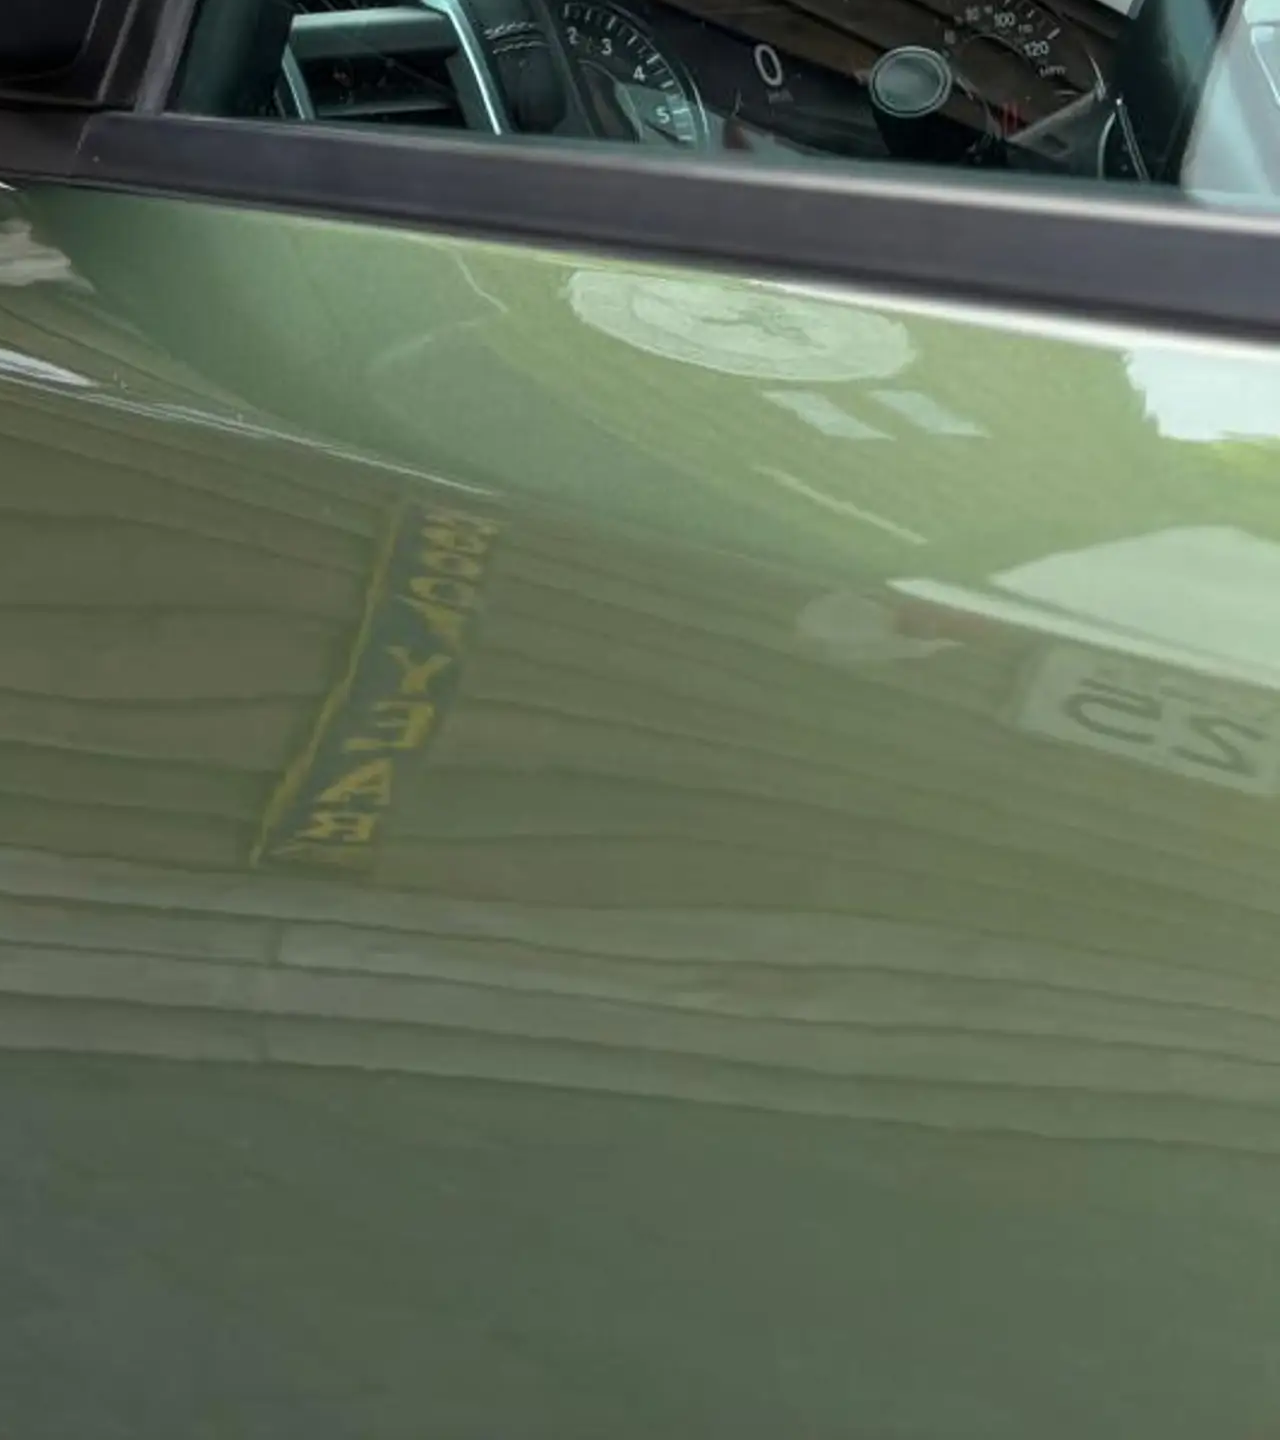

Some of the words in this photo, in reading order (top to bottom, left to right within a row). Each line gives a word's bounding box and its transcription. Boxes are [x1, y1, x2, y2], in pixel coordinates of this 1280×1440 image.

[993, 12, 1017, 28] 100
[566, 25, 579, 45] 2
[600, 38, 613, 56] 3
[1023, 40, 1051, 58] 120
[632, 65, 647, 82] 4
[753, 43, 783, 88] 0
[655, 107, 671, 124] 5
